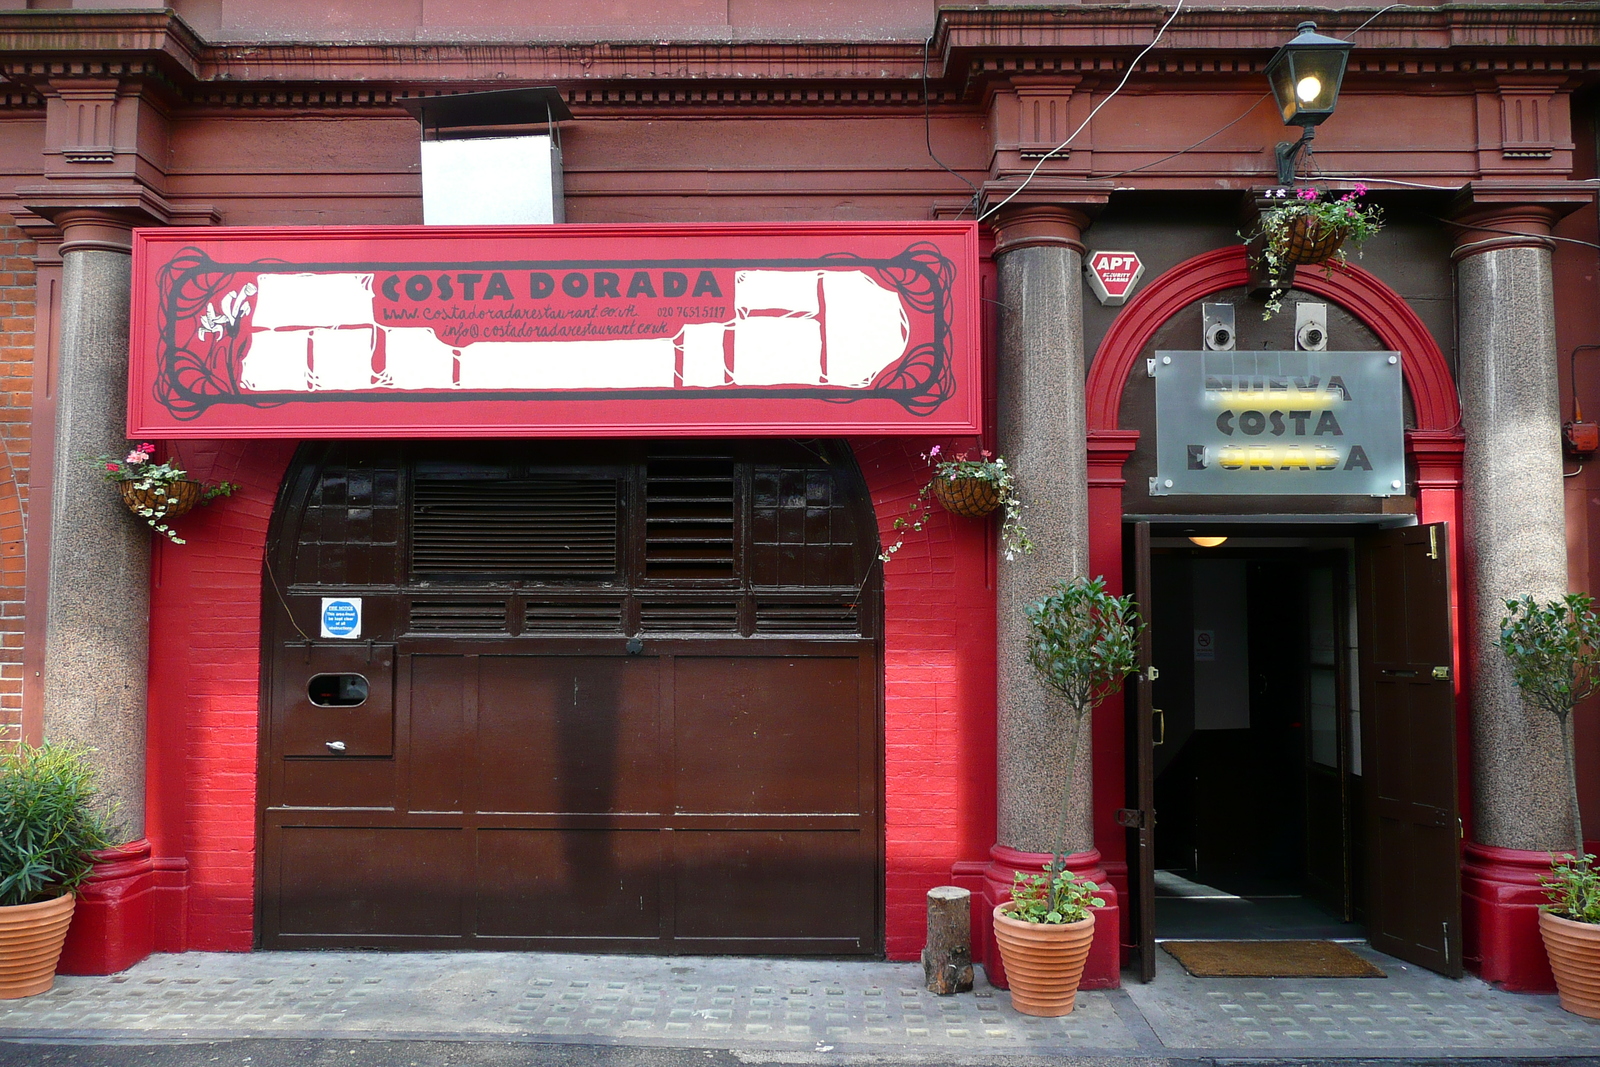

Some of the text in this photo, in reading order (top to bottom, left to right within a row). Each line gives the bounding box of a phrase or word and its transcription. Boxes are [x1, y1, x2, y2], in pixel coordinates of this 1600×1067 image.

[1096, 257, 1135, 270] APT
[381, 271, 723, 301] COSTA DORADA
[657, 306, 674, 317] 020
[1216, 410, 1343, 437] COSTA
[1186, 445, 1373, 471] DORADA
